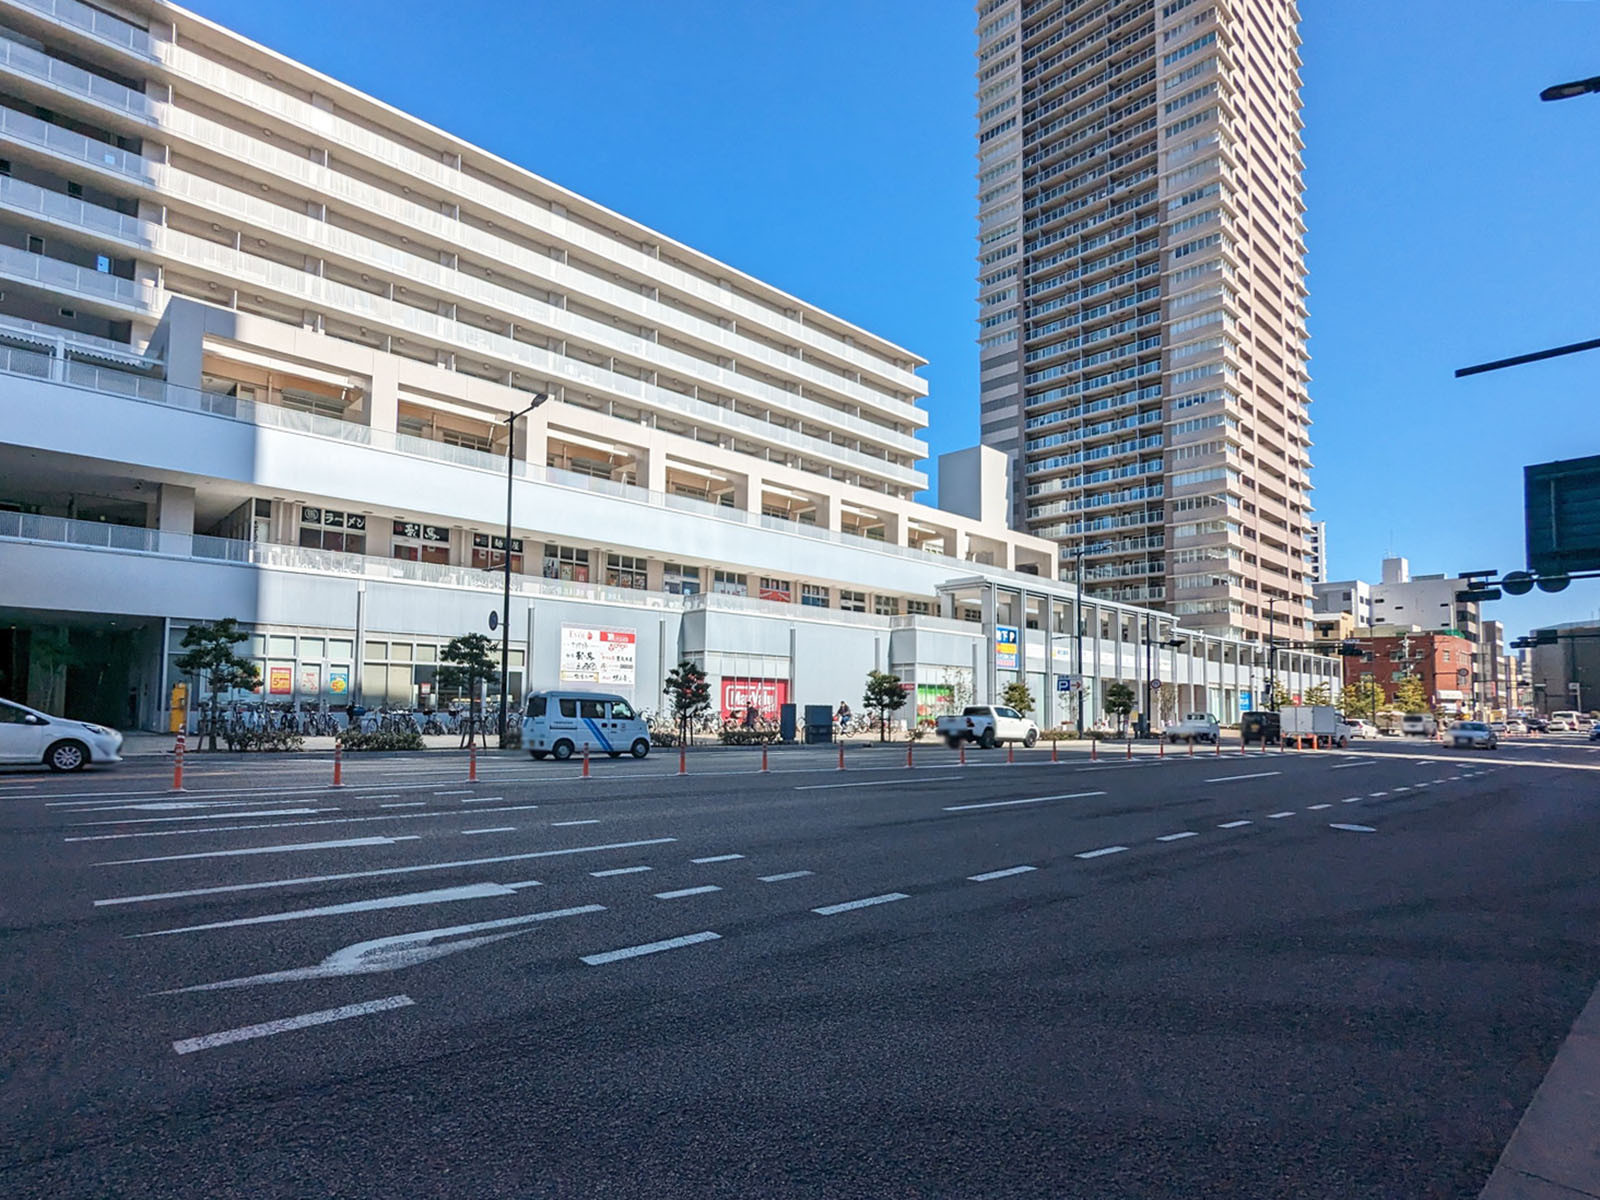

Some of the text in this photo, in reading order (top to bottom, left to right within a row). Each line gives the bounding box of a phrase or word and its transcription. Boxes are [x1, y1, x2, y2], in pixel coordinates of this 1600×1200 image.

[325, 513, 365, 528] ラーメン
[1059, 680, 1069, 691] P
